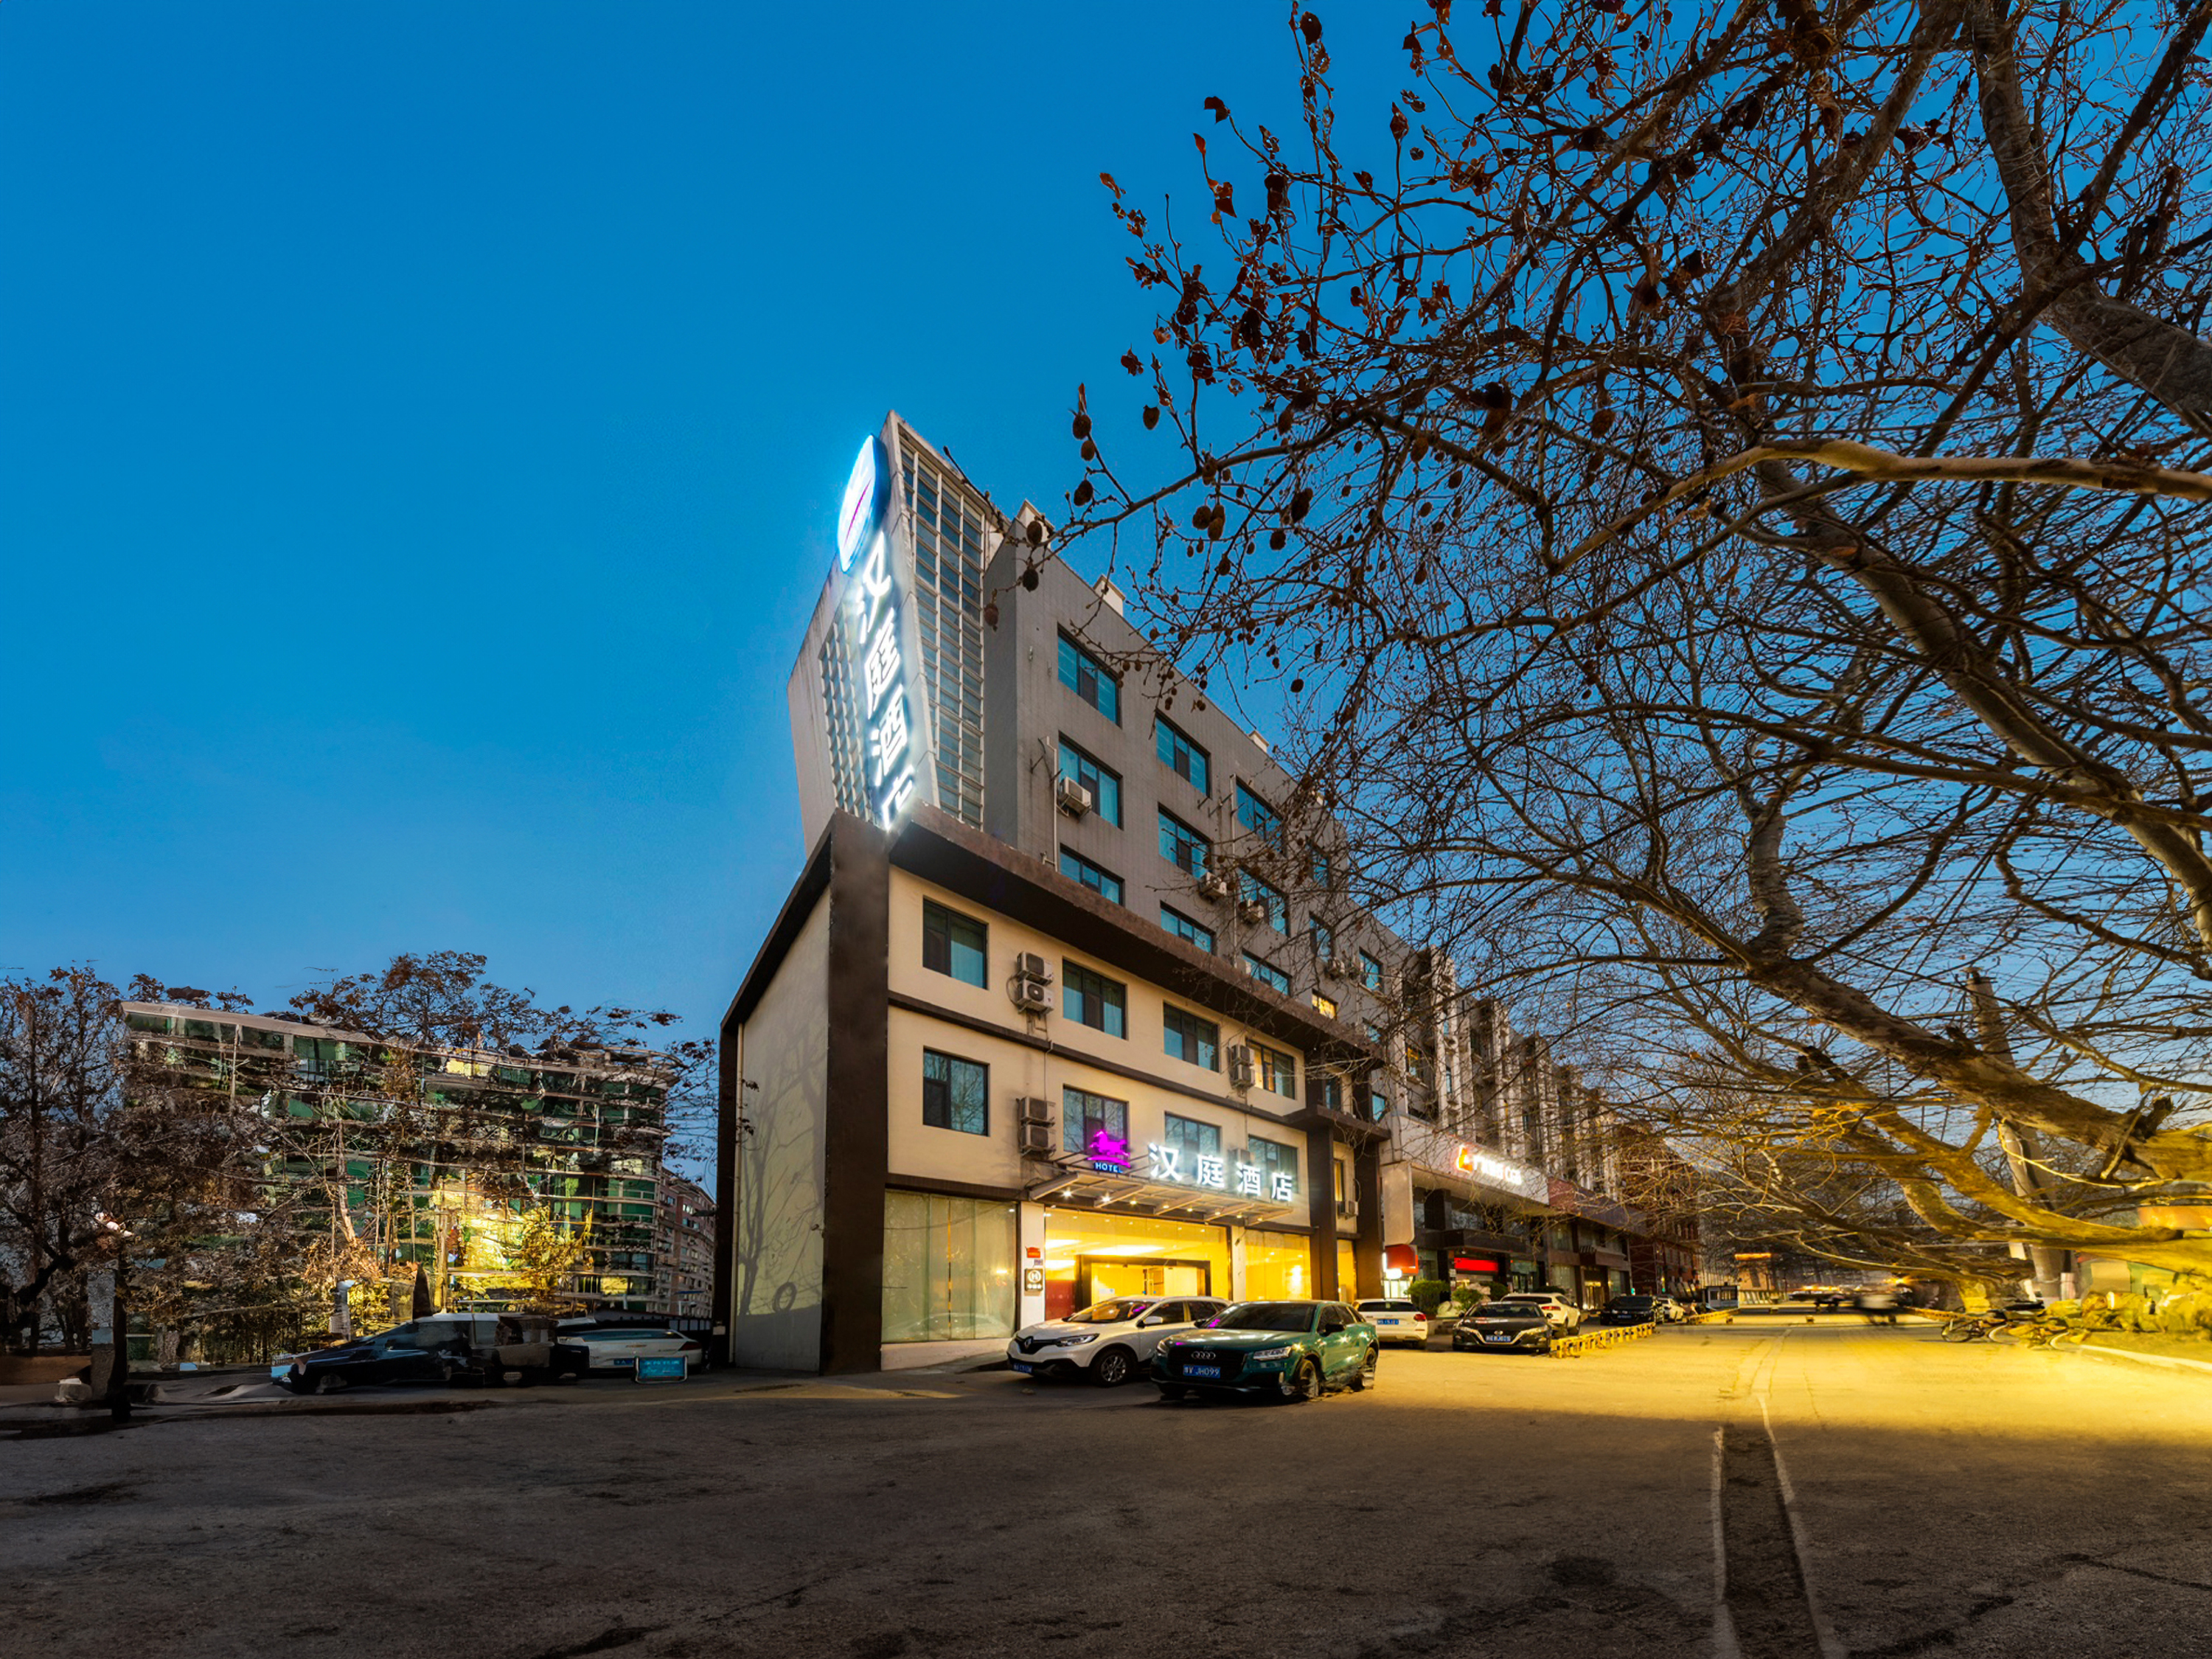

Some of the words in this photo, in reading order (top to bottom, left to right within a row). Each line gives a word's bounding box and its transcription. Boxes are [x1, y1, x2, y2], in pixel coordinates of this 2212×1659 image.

[1095, 1162, 1124, 1174] HOTEL
[1147, 1142, 1295, 1202] 汉庭酒店
